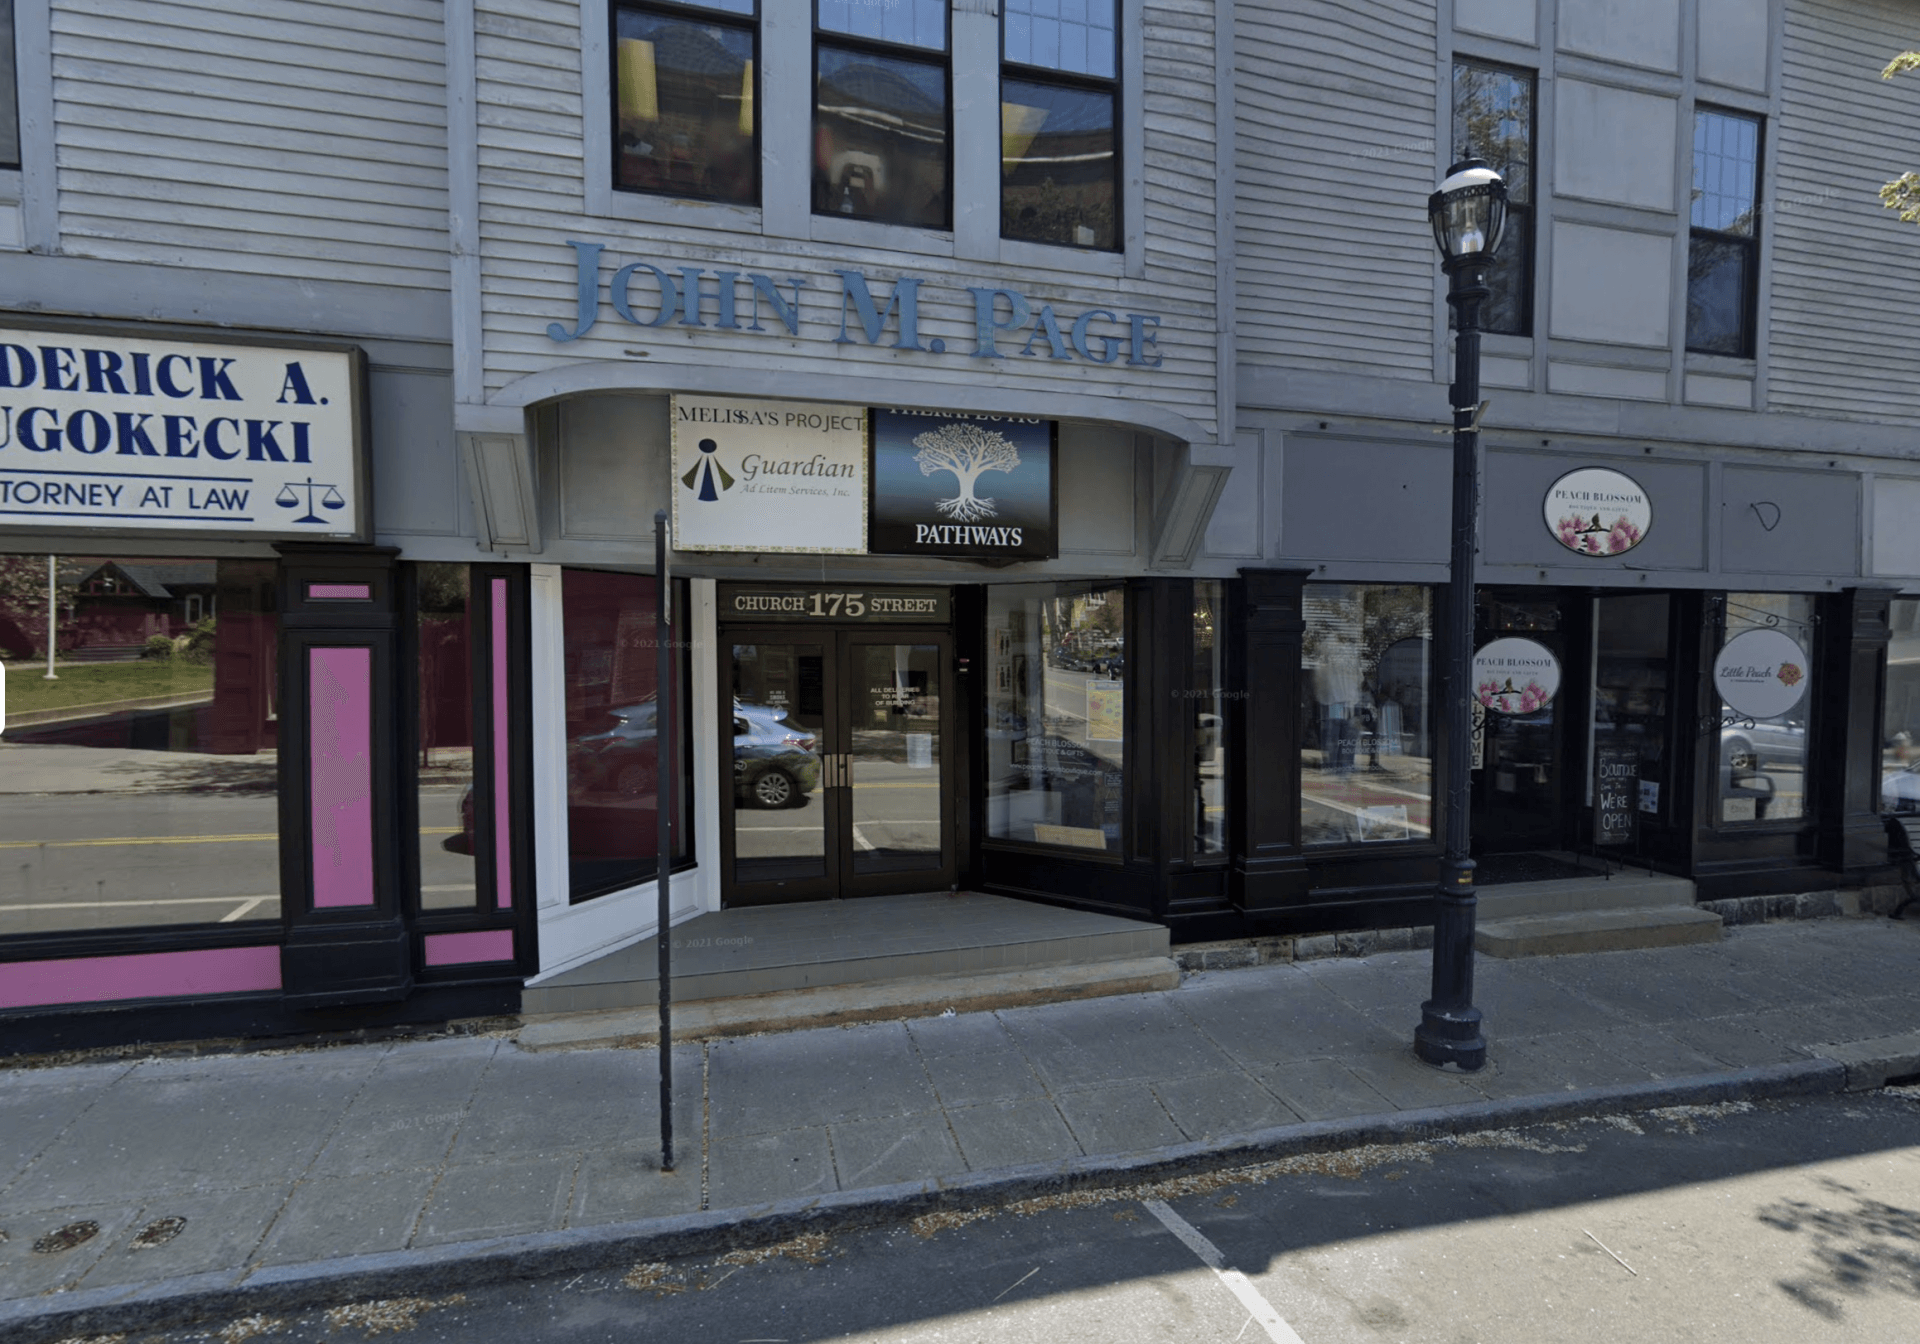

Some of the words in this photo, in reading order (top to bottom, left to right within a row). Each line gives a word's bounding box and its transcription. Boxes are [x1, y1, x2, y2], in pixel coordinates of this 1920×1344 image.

[545, 239, 806, 343] JOHN
[831, 269, 946, 355] M.
[967, 286, 1163, 368] PAGE
[0, 343, 243, 401] DERICK
[275, 361, 329, 405] A.
[785, 411, 864, 433] PROJECT
[740, 454, 855, 481] Guardian
[0, 480, 124, 508] TORNEY
[139, 486, 173, 509] AT
[188, 487, 250, 511] LAW
[739, 483, 756, 495] Ad
[758, 485, 787, 495] Litem
[788, 485, 829, 498] Services,
[832, 487, 851, 497] Inc.
[1555, 490, 1590, 501] PEACH
[1593, 492, 1642, 504] BLOSSOM
[915, 524, 1023, 547] PATHWAYS
[735, 595, 805, 611] CHURCH
[809, 593, 866, 617] 175
[870, 598, 937, 613] STREET
[1476, 657, 1504, 666] PEACH
[1507, 658, 1551, 667] BLOSSOM
[1720, 666, 1744, 678] Little
[1746, 666, 1771, 678] Peach
[1026, 738, 1051, 747] PEACH
[1052, 740, 1090, 749] BLOSSOM
[1602, 812, 1632, 830] OPEN
